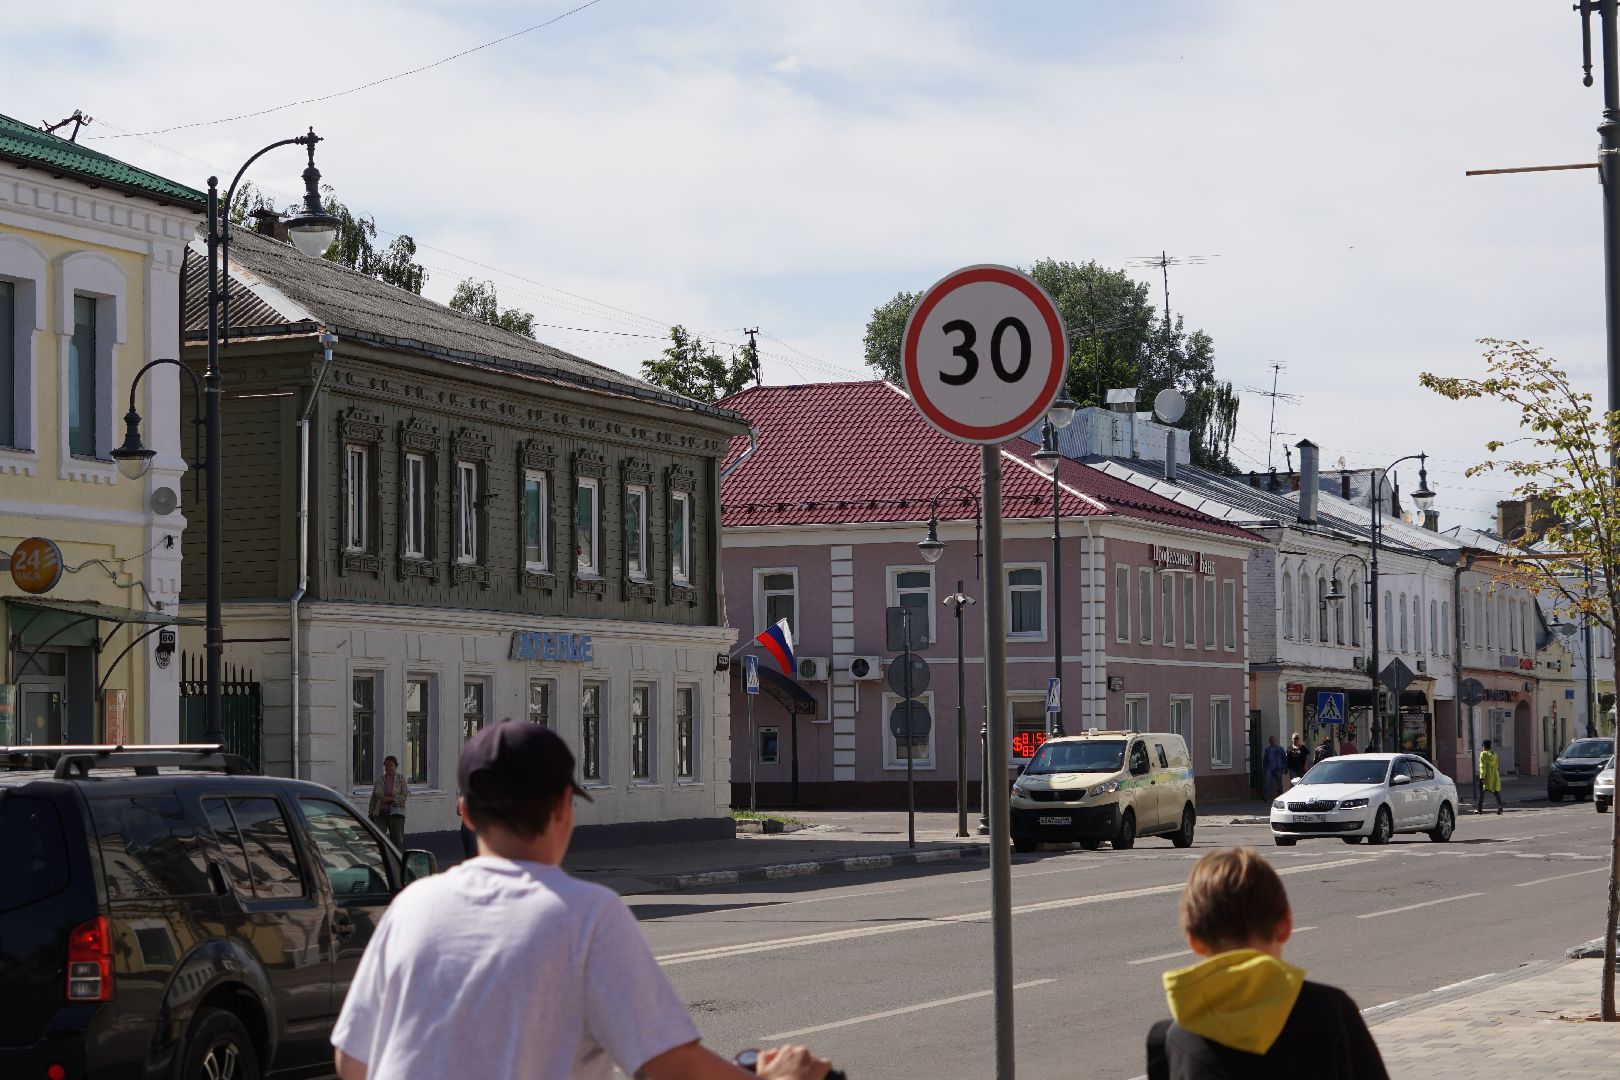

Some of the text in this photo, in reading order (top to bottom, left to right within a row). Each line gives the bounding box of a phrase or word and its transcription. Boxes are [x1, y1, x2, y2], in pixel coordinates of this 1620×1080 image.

[939, 316, 1032, 386] 30
[15, 549, 40, 570] 24
[518, 631, 593, 662] АТЕЛЬЕ
